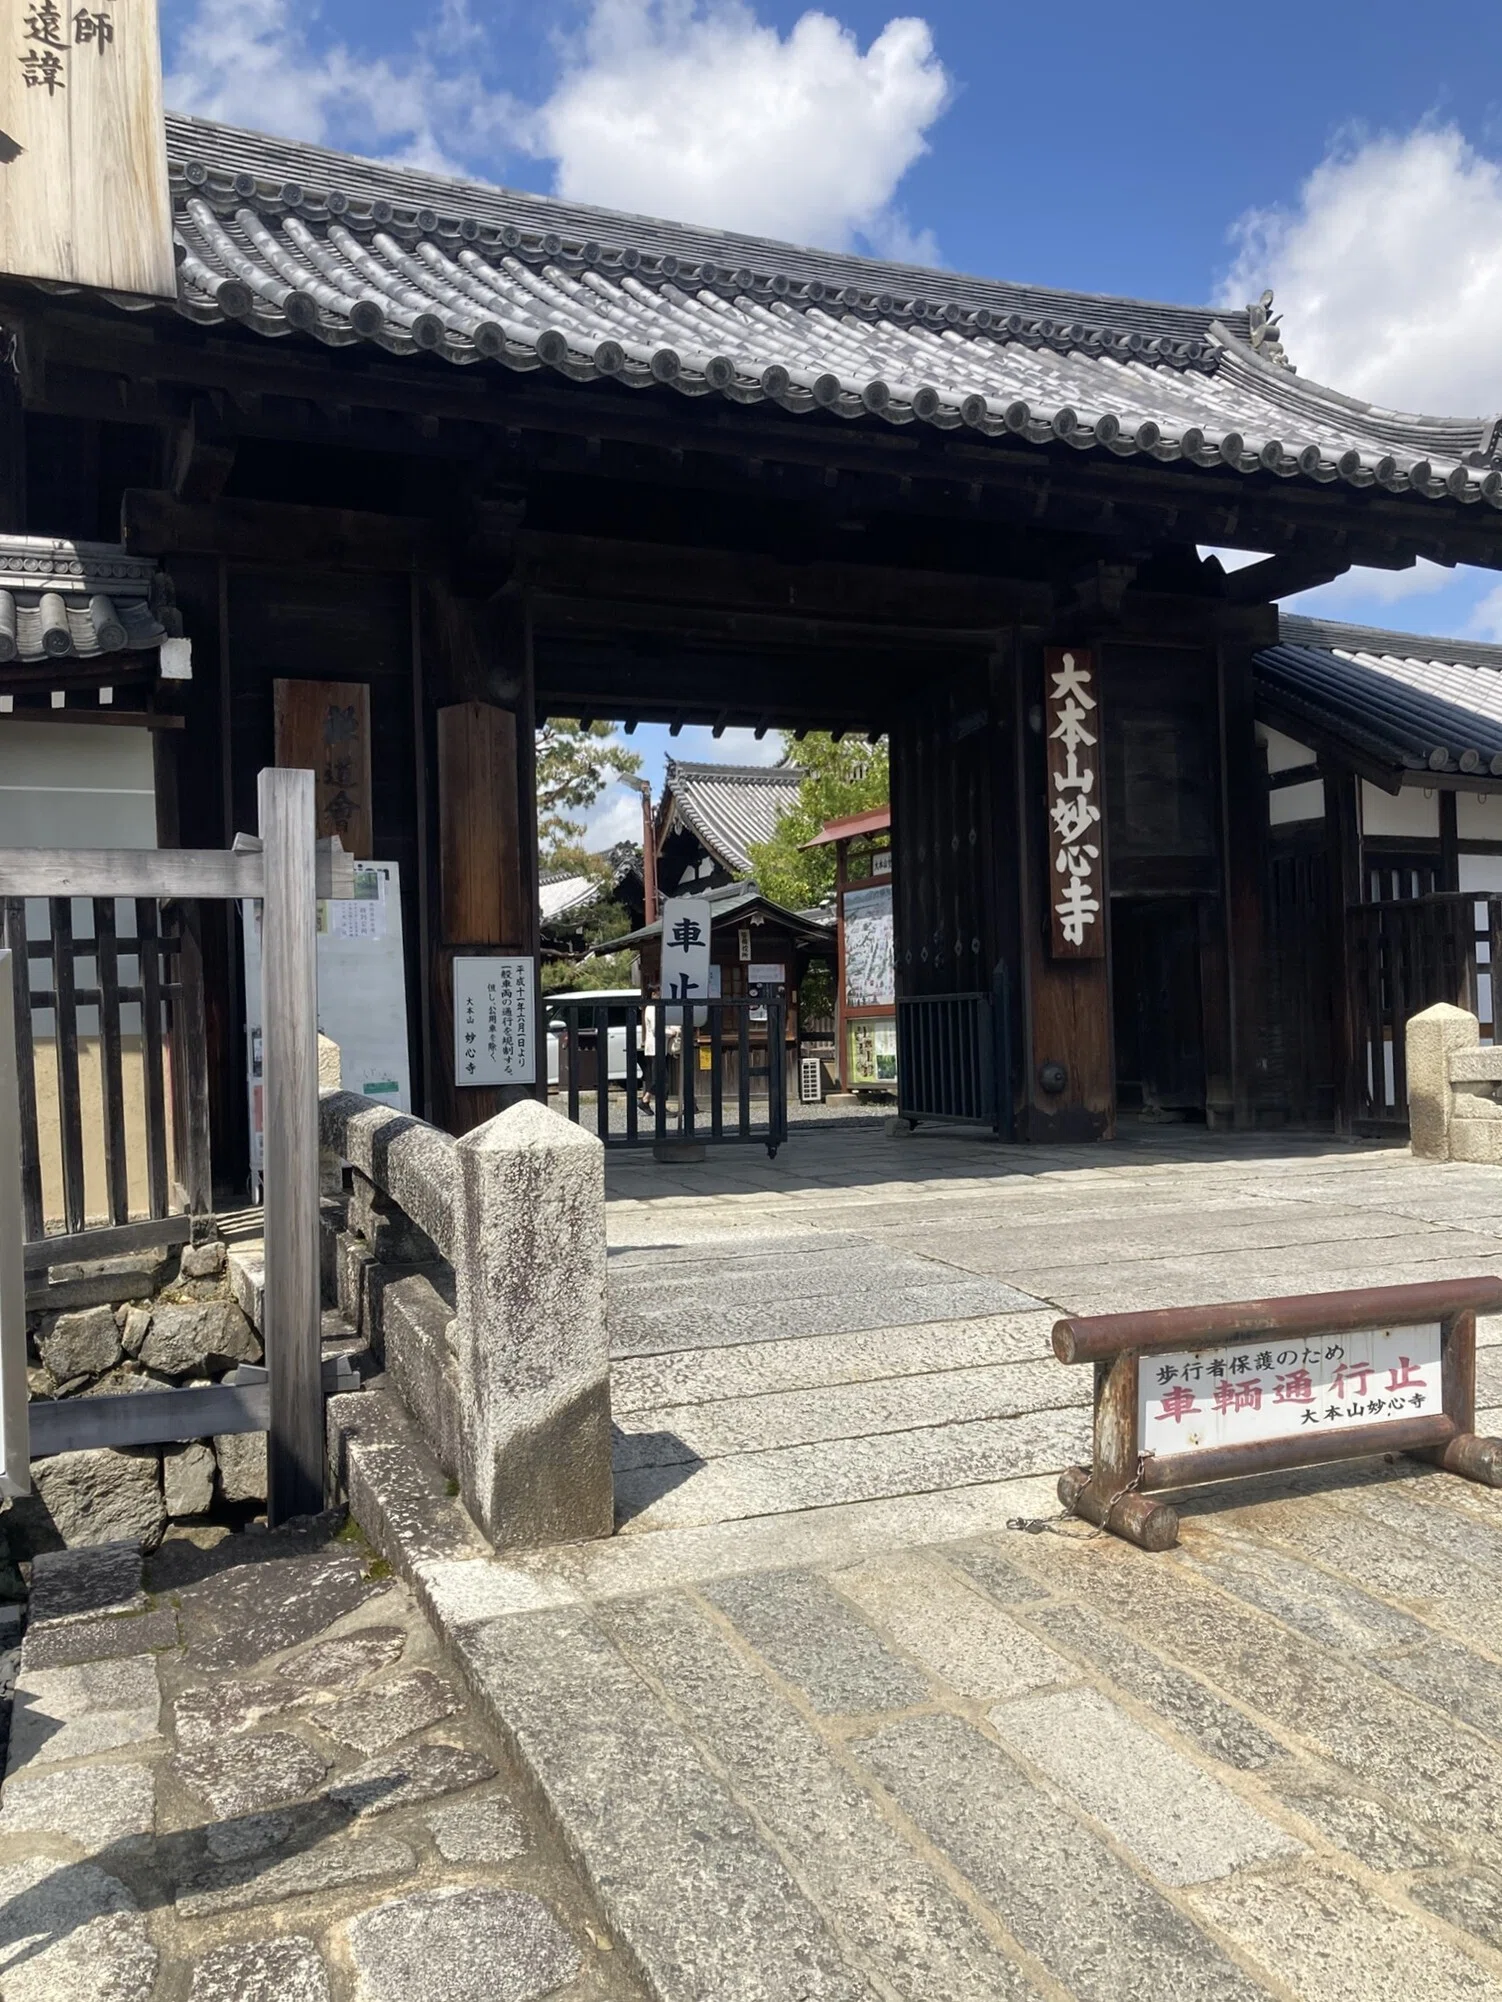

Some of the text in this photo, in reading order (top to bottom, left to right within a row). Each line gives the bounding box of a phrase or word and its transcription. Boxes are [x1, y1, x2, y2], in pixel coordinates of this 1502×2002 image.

[1049, 652, 1101, 946] 大本山妙心寺
[667, 917, 706, 999] 車止
[515, 964, 527, 1068] 平成十一年六月一日より
[1155, 1343, 1346, 1386] 歩行者保護のため
[1300, 1391, 1428, 1427] 大本山妙心寺
